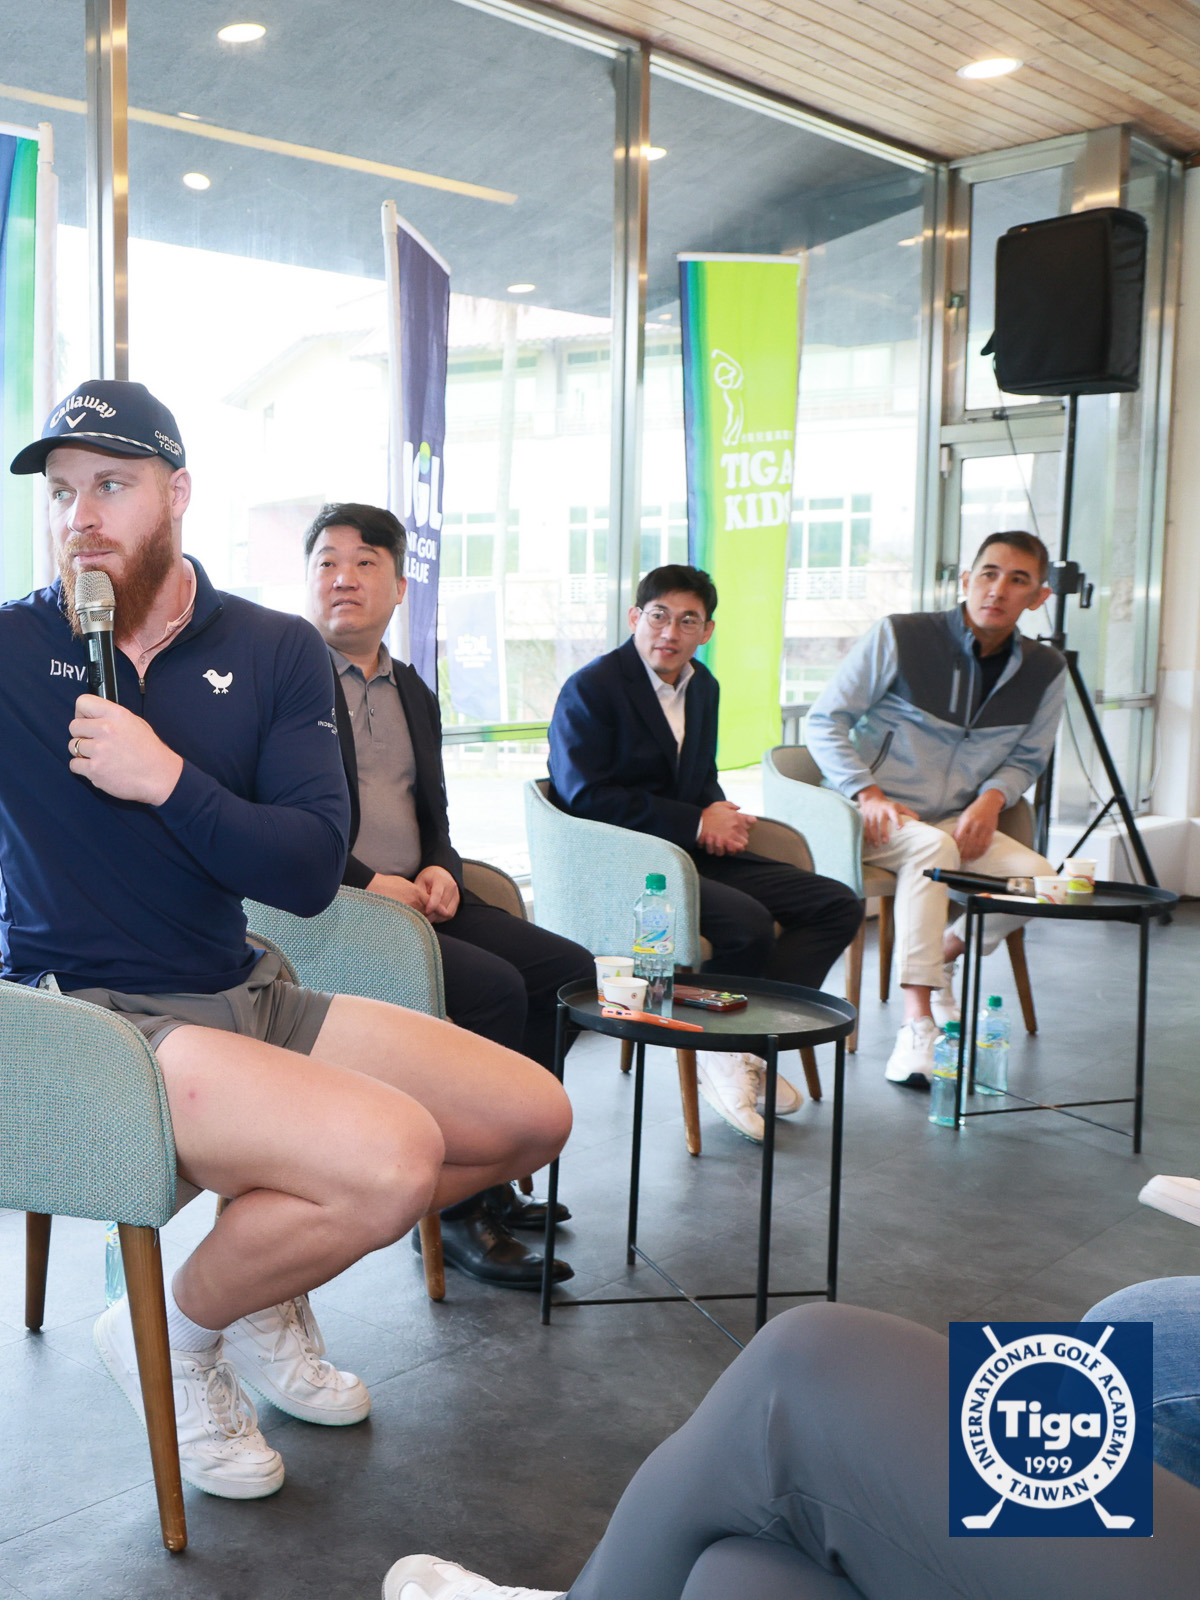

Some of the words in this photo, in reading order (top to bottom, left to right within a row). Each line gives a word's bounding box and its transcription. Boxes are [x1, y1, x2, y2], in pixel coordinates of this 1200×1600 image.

[50, 395, 117, 428] Callaway
[720, 449, 793, 489] TIGA
[418, 537, 437, 560] GOL
[50, 659, 89, 683] DRV
